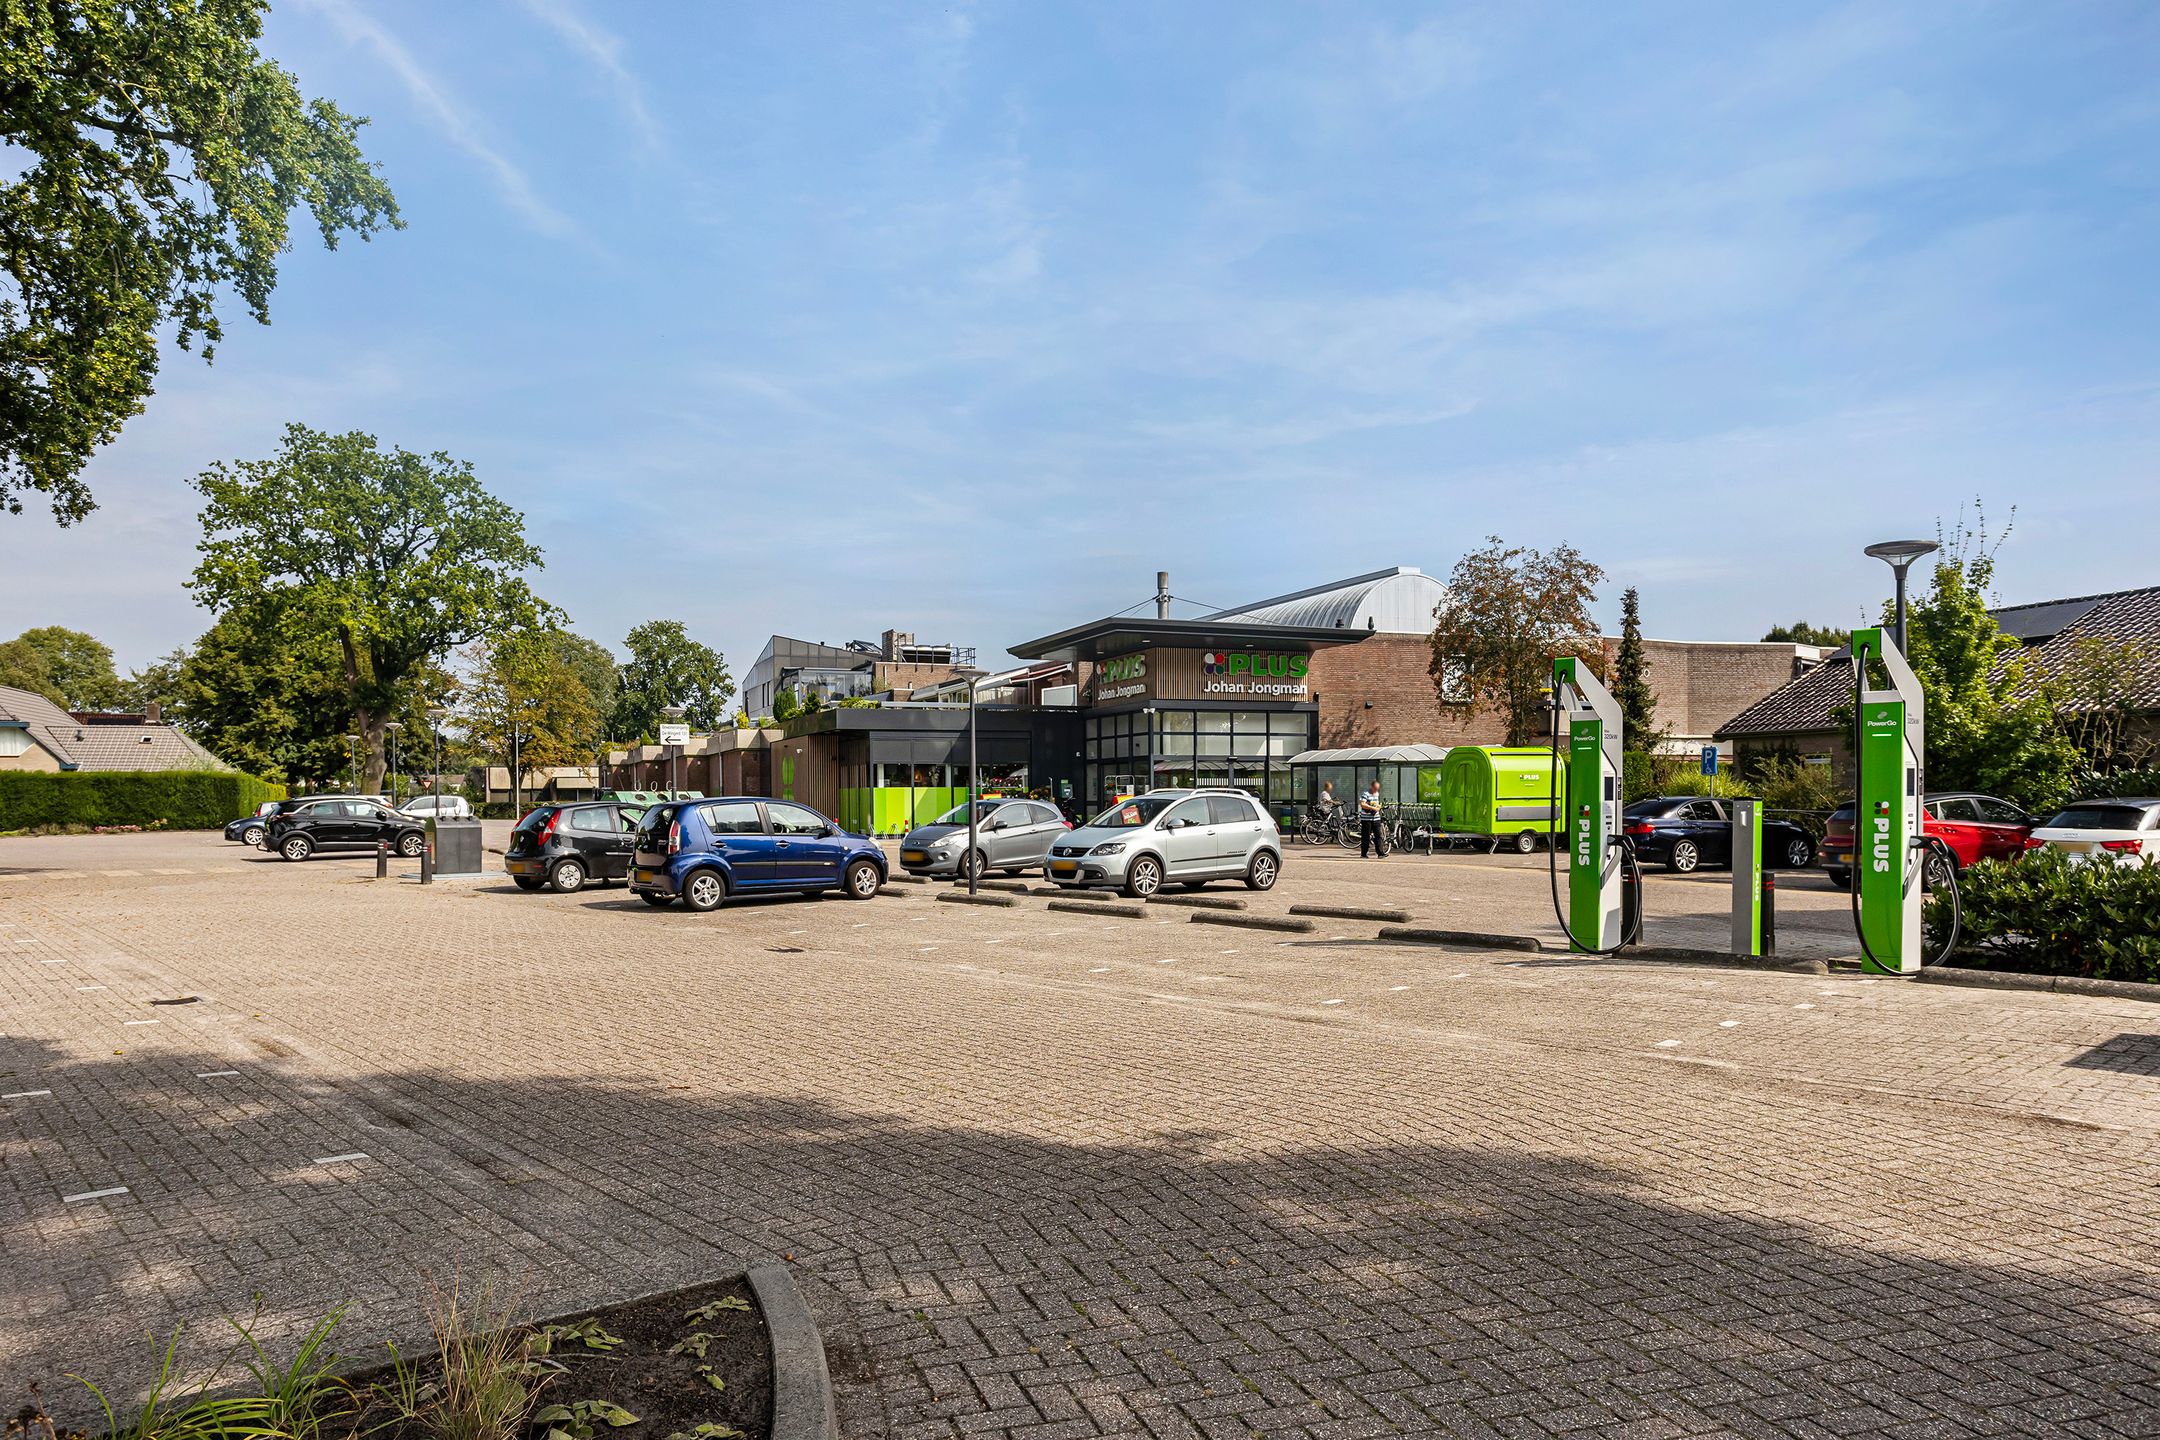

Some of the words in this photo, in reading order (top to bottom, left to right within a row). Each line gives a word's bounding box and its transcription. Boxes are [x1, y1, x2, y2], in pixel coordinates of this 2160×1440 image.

[1106, 655, 1146, 682] PLUS
[1229, 653, 1309, 678] PLUS
[1098, 688, 1115, 700] Johan
[1116, 684, 1146, 698] Jongman
[1204, 681, 1244, 693] Johan
[1248, 682, 1308, 696] Jongman
[1704, 750, 1713, 764] P
[1578, 819, 1590, 866] PLUS
[1873, 818, 1889, 873] PLUS
